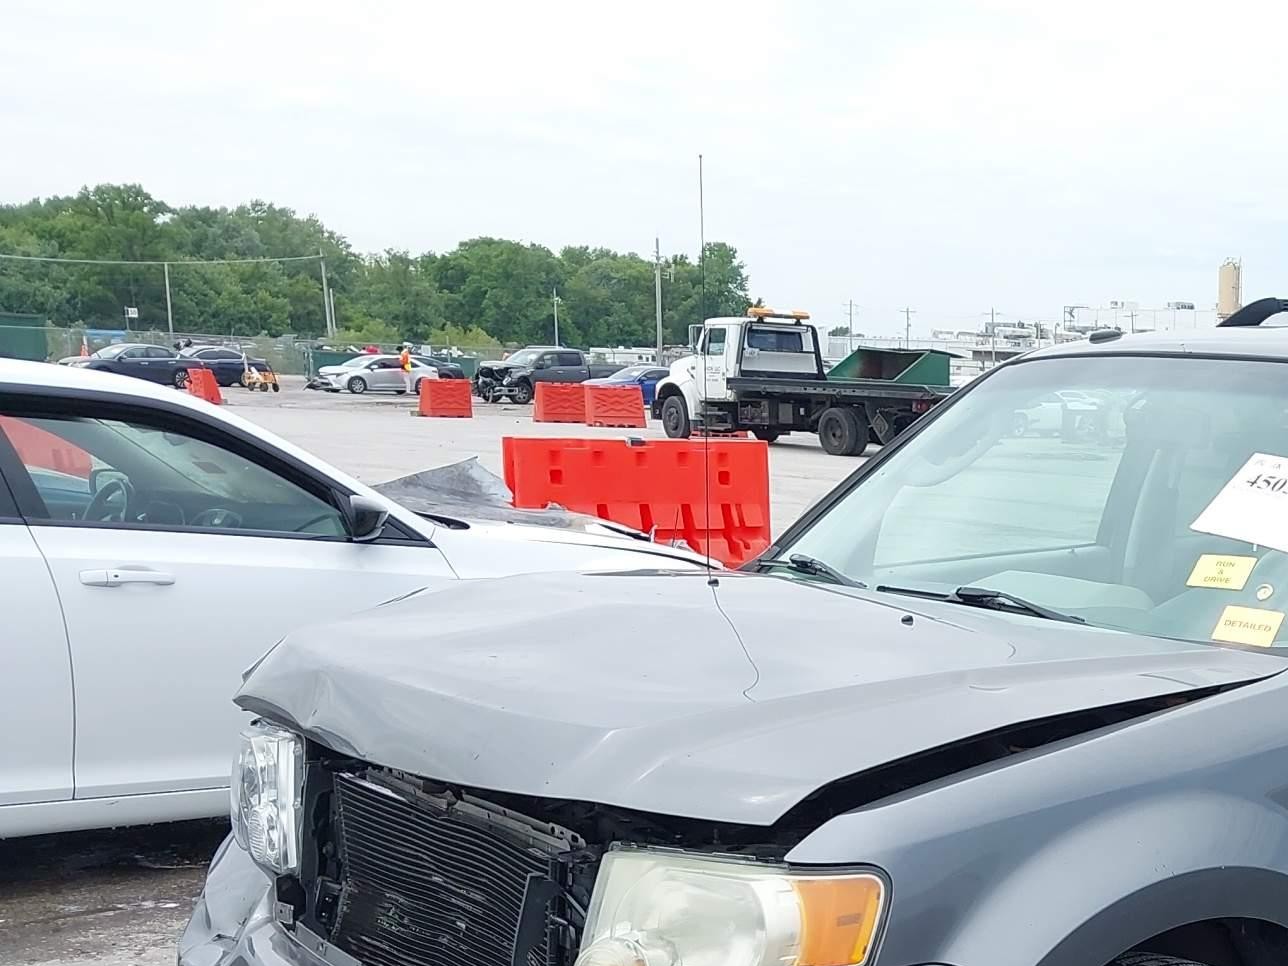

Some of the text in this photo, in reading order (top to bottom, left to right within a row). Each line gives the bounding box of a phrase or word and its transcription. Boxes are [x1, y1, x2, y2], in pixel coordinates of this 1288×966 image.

[1216, 560, 1236, 568] RUN
[1203, 576, 1232, 584] DRIVE
[1223, 619, 1272, 632] DETAILED
